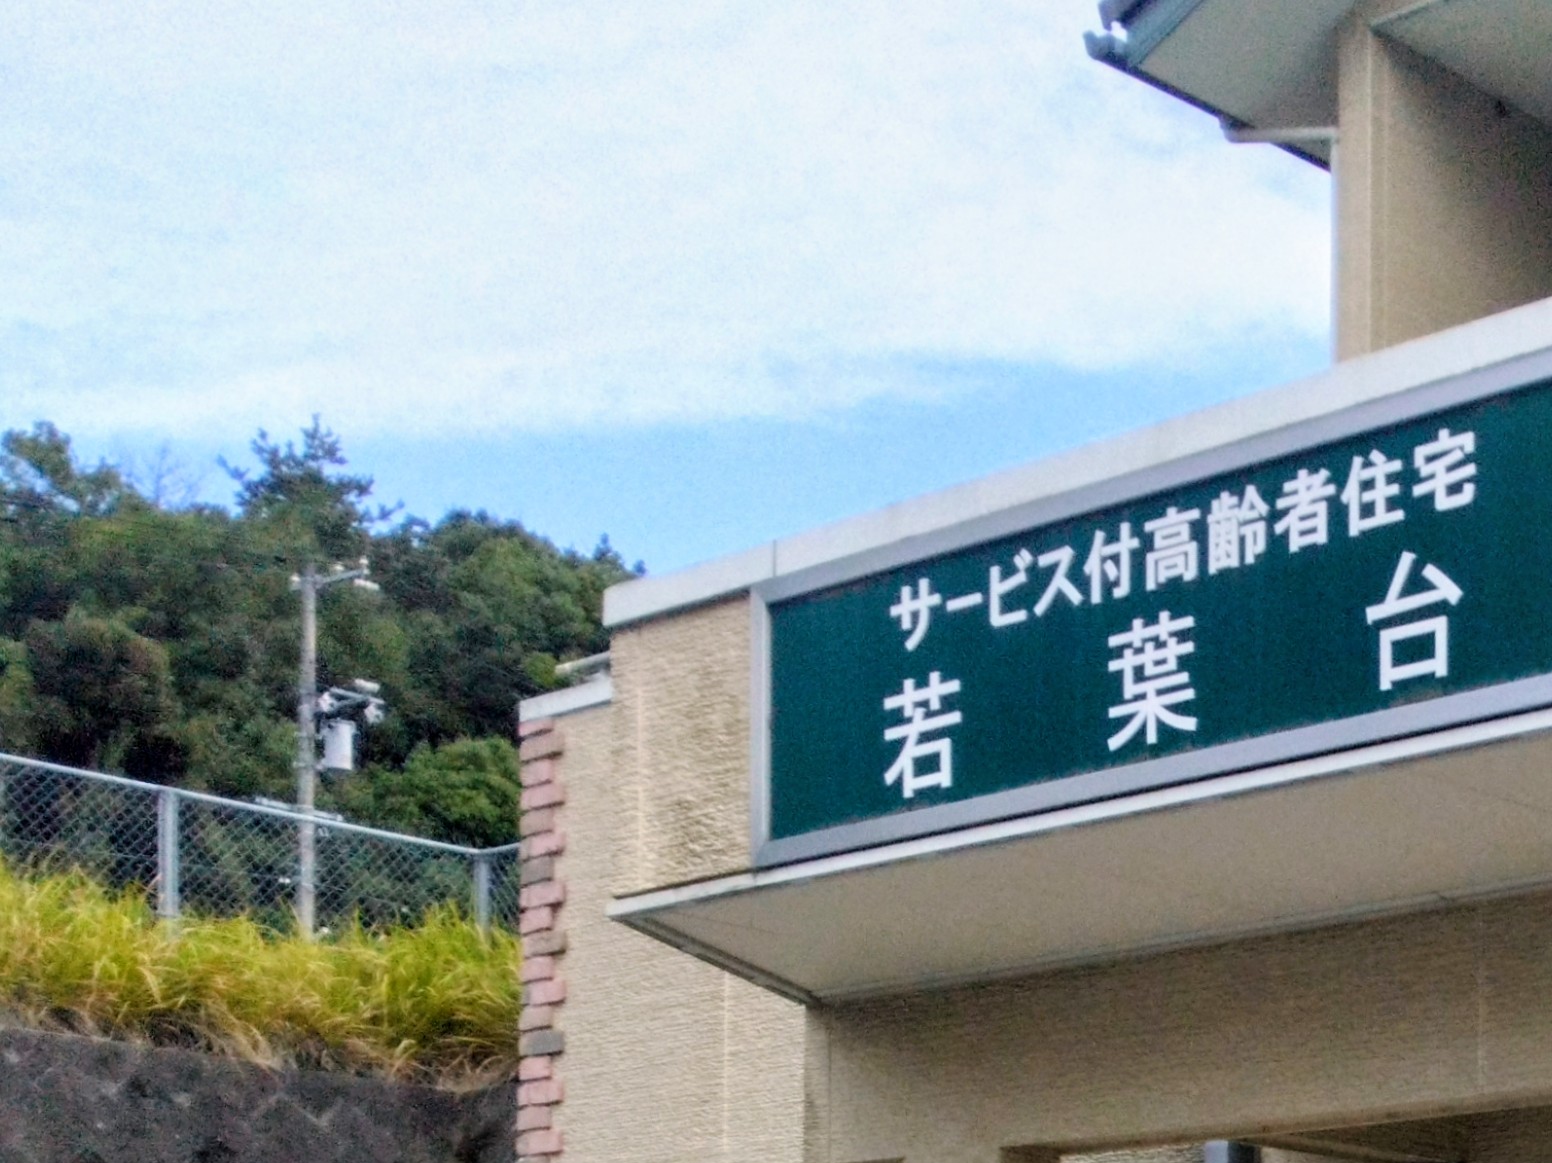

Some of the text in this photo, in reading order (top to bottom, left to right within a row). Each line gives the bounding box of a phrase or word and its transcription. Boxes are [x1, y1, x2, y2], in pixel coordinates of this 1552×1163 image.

[889, 428, 1477, 651] サービス付高齢者住宅
